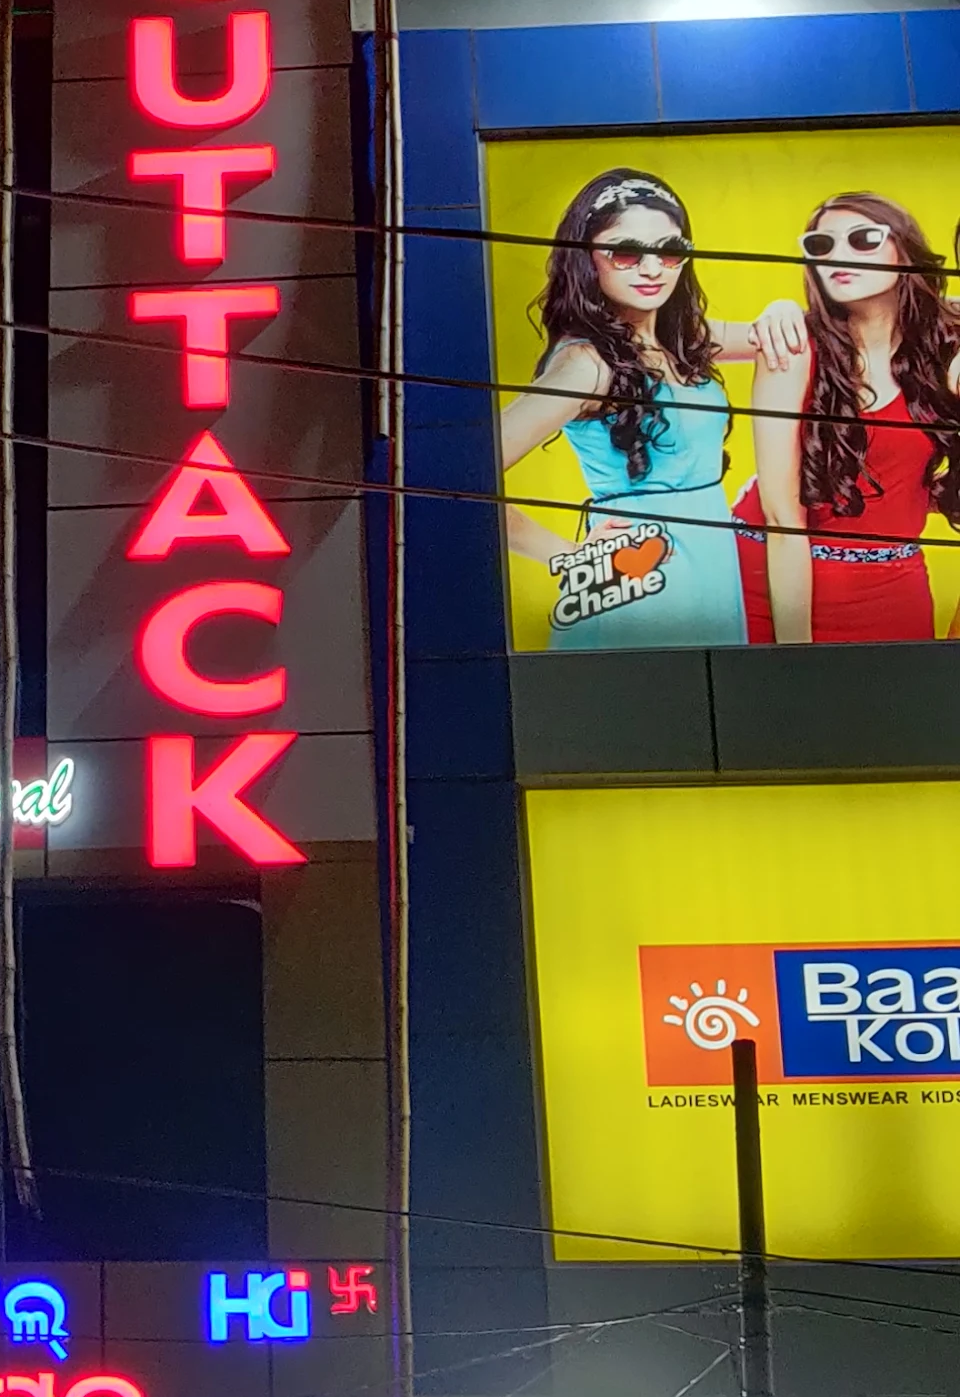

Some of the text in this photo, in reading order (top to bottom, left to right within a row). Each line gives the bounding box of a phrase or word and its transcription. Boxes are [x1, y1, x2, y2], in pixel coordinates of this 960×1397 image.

[550, 523, 660, 574] Fashion Jo
[568, 553, 614, 594] Dil
[554, 570, 664, 624] Chahe
[803, 962, 960, 1014] Baa
[846, 1014, 960, 1063] Kol
[648, 1090, 960, 1109] LADIESWAR MENSWEAR KIDS
